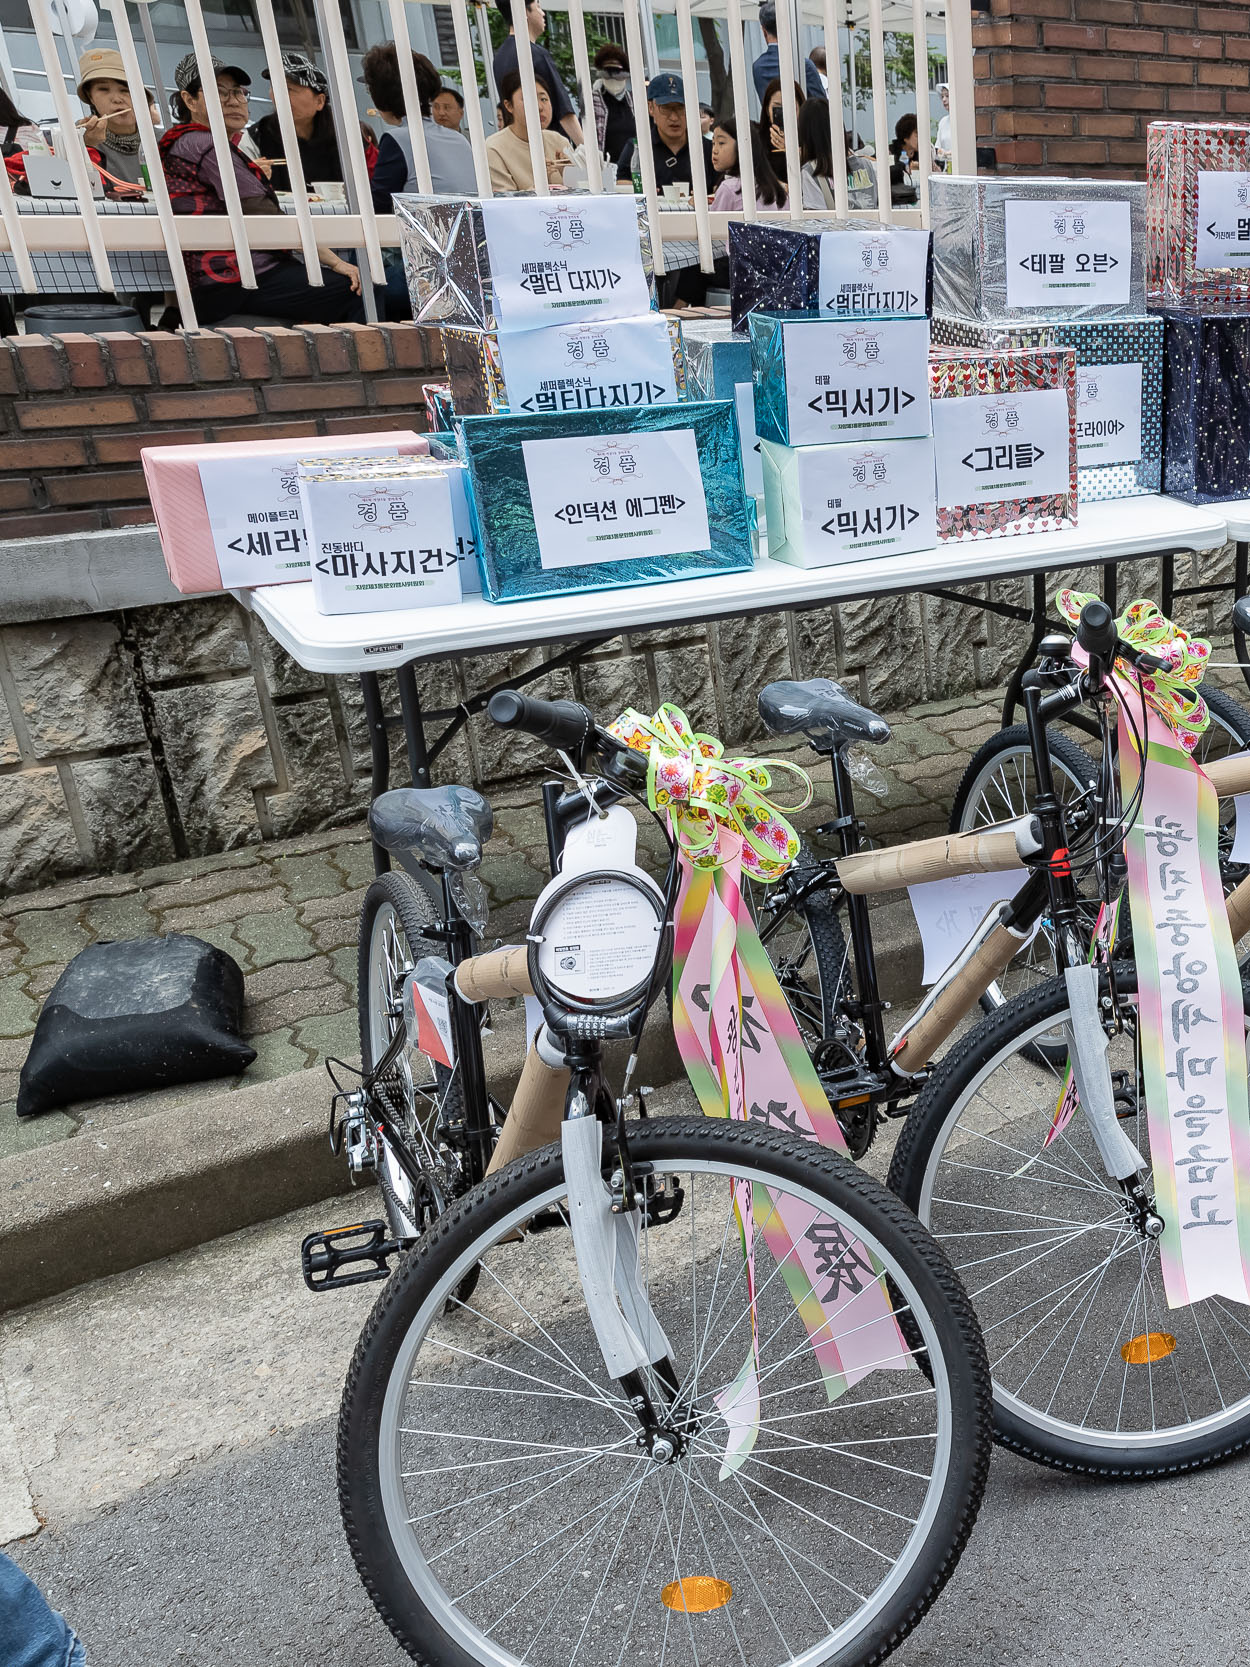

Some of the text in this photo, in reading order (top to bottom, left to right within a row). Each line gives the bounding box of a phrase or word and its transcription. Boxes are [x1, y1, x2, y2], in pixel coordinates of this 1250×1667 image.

[1019, 253, 1119, 274] <테팔 오븐>
[520, 269, 622, 295] <멀티 다지기>
[807, 387, 916, 418] <믹서기>
[961, 443, 1045, 472] <그리들>
[248, 510, 299, 524] 메이플트리
[554, 494, 686, 525] <인덕션 에그펜>
[821, 504, 920, 538] <믹서기>
[227, 529, 308, 556] <세라
[321, 541, 364, 554] 진동바디
[315, 548, 459, 579] <마사지건>
